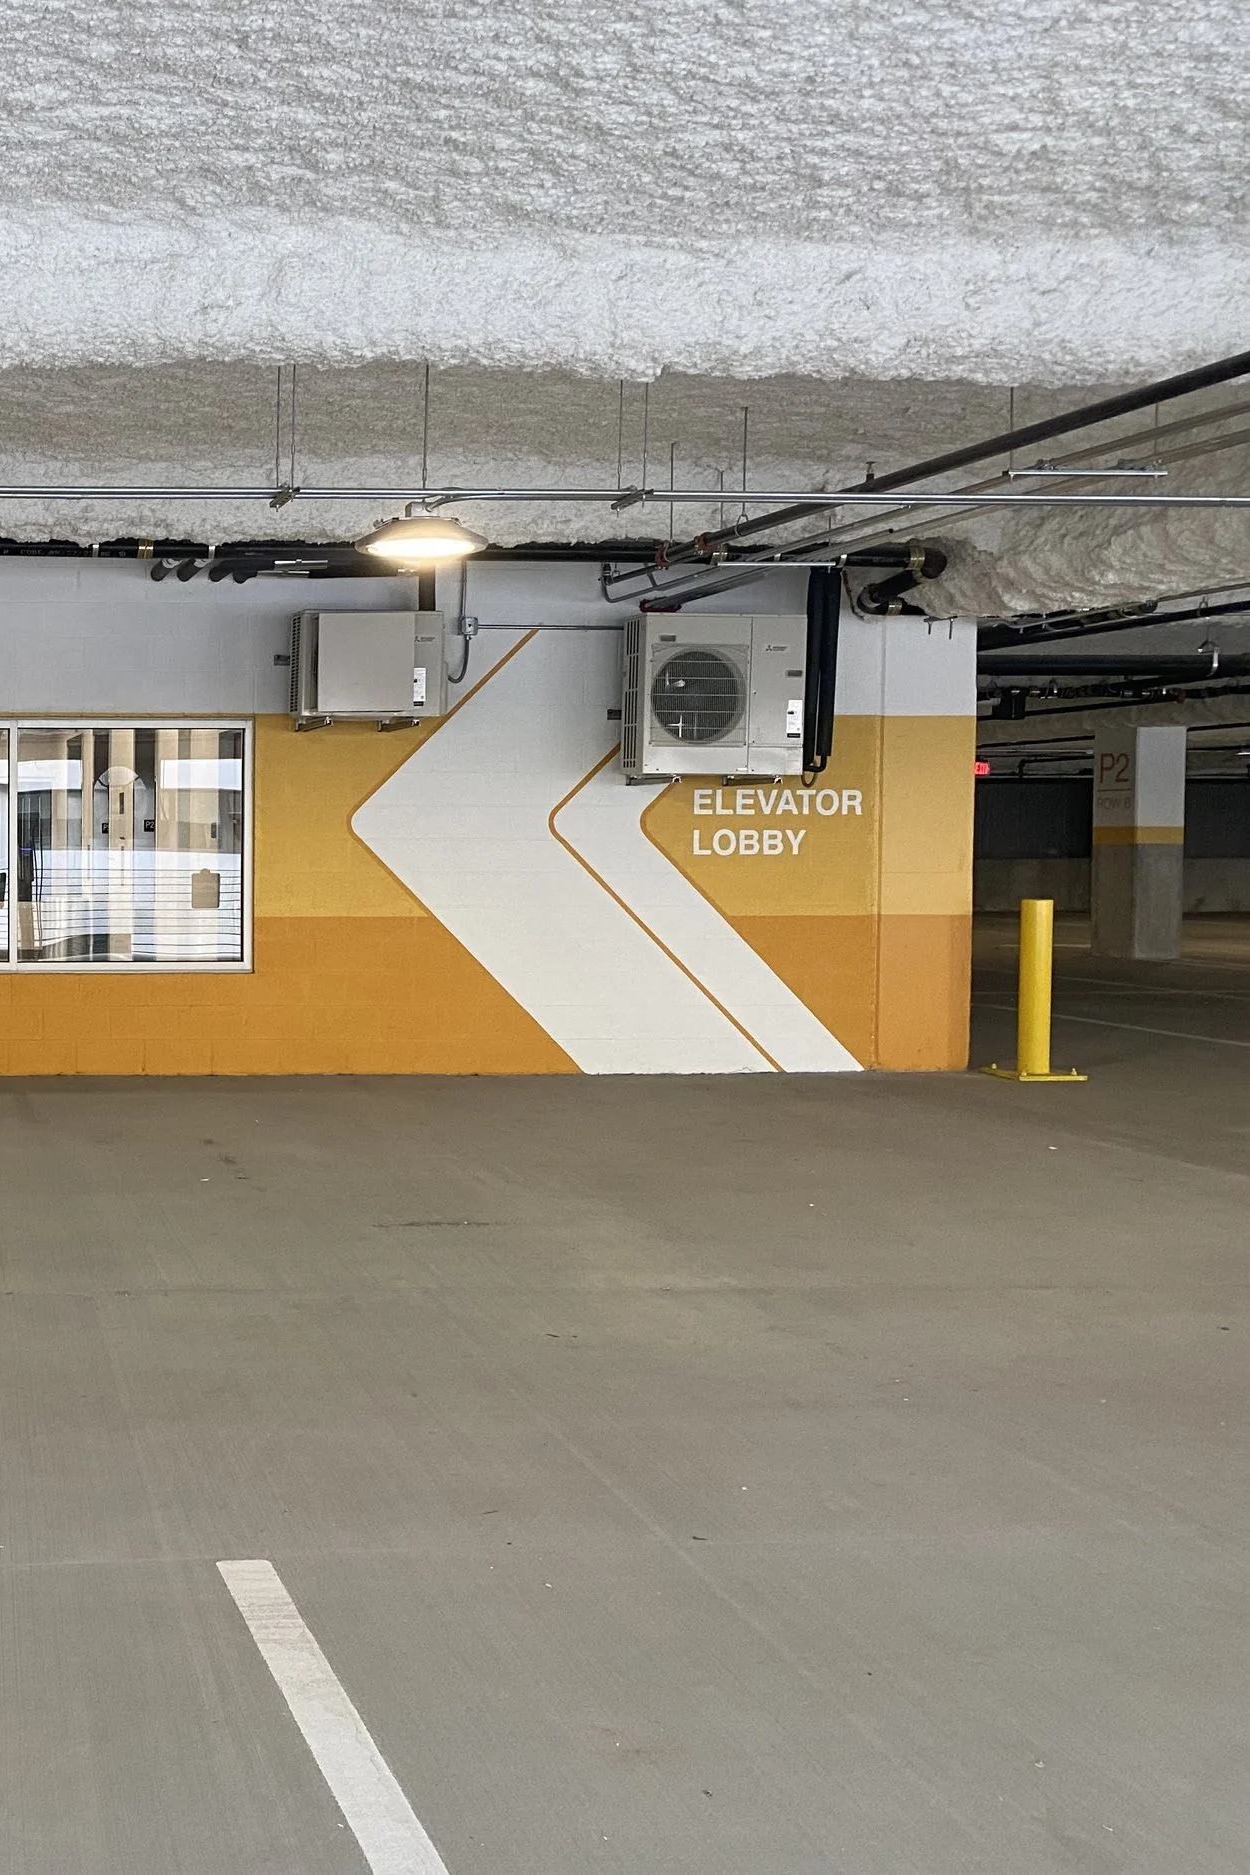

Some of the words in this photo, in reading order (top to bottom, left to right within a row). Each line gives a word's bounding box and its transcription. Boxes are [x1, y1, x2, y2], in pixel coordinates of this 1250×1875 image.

[1100, 753, 1130, 784] P2
[693, 789, 863, 816] ELEVATOR
[1097, 797, 1121, 809] ROW
[145, 820, 155, 829] P2
[693, 829, 807, 856] LOBBY
